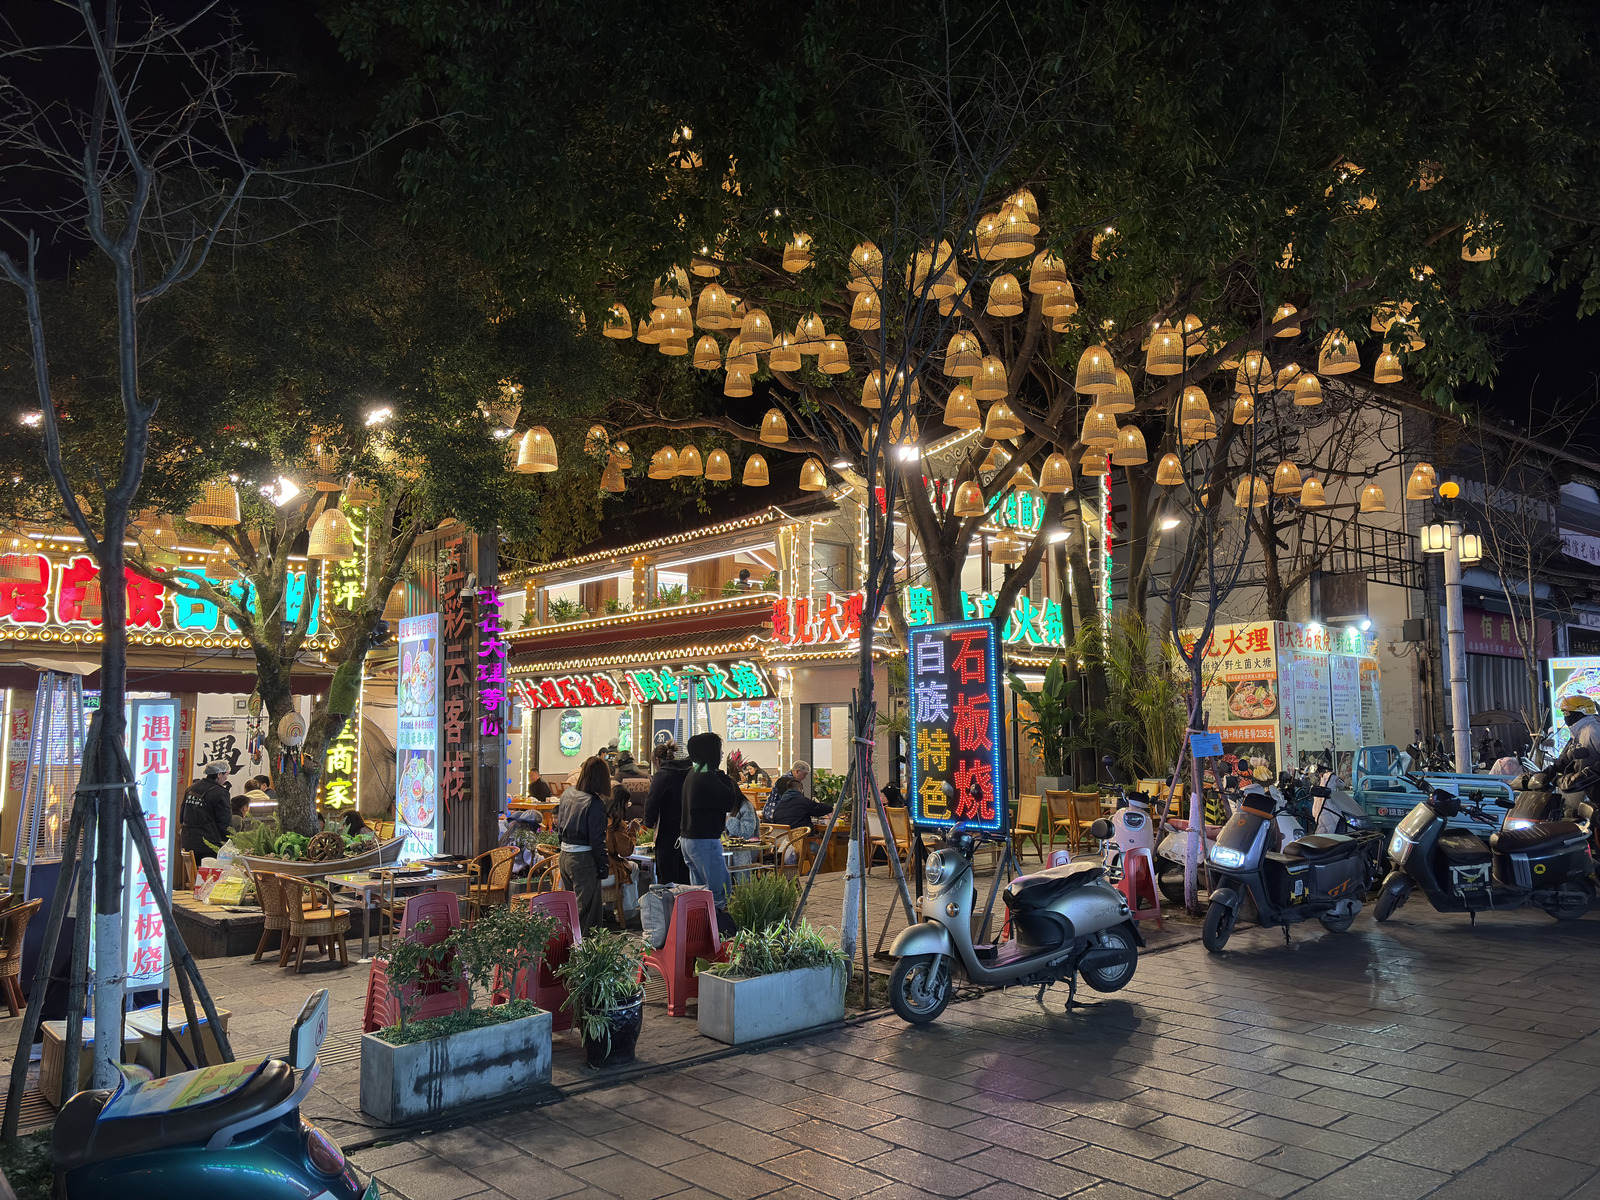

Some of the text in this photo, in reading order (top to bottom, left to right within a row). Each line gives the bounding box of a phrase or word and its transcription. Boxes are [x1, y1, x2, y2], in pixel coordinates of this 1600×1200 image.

[441, 537, 466, 802] 五彩云客栈
[478, 585, 507, 737] 我在大理等你
[524, 677, 622, 709] 大理石板烧
[914, 634, 951, 821] 白族特色
[951, 630, 996, 821] 石板烧
